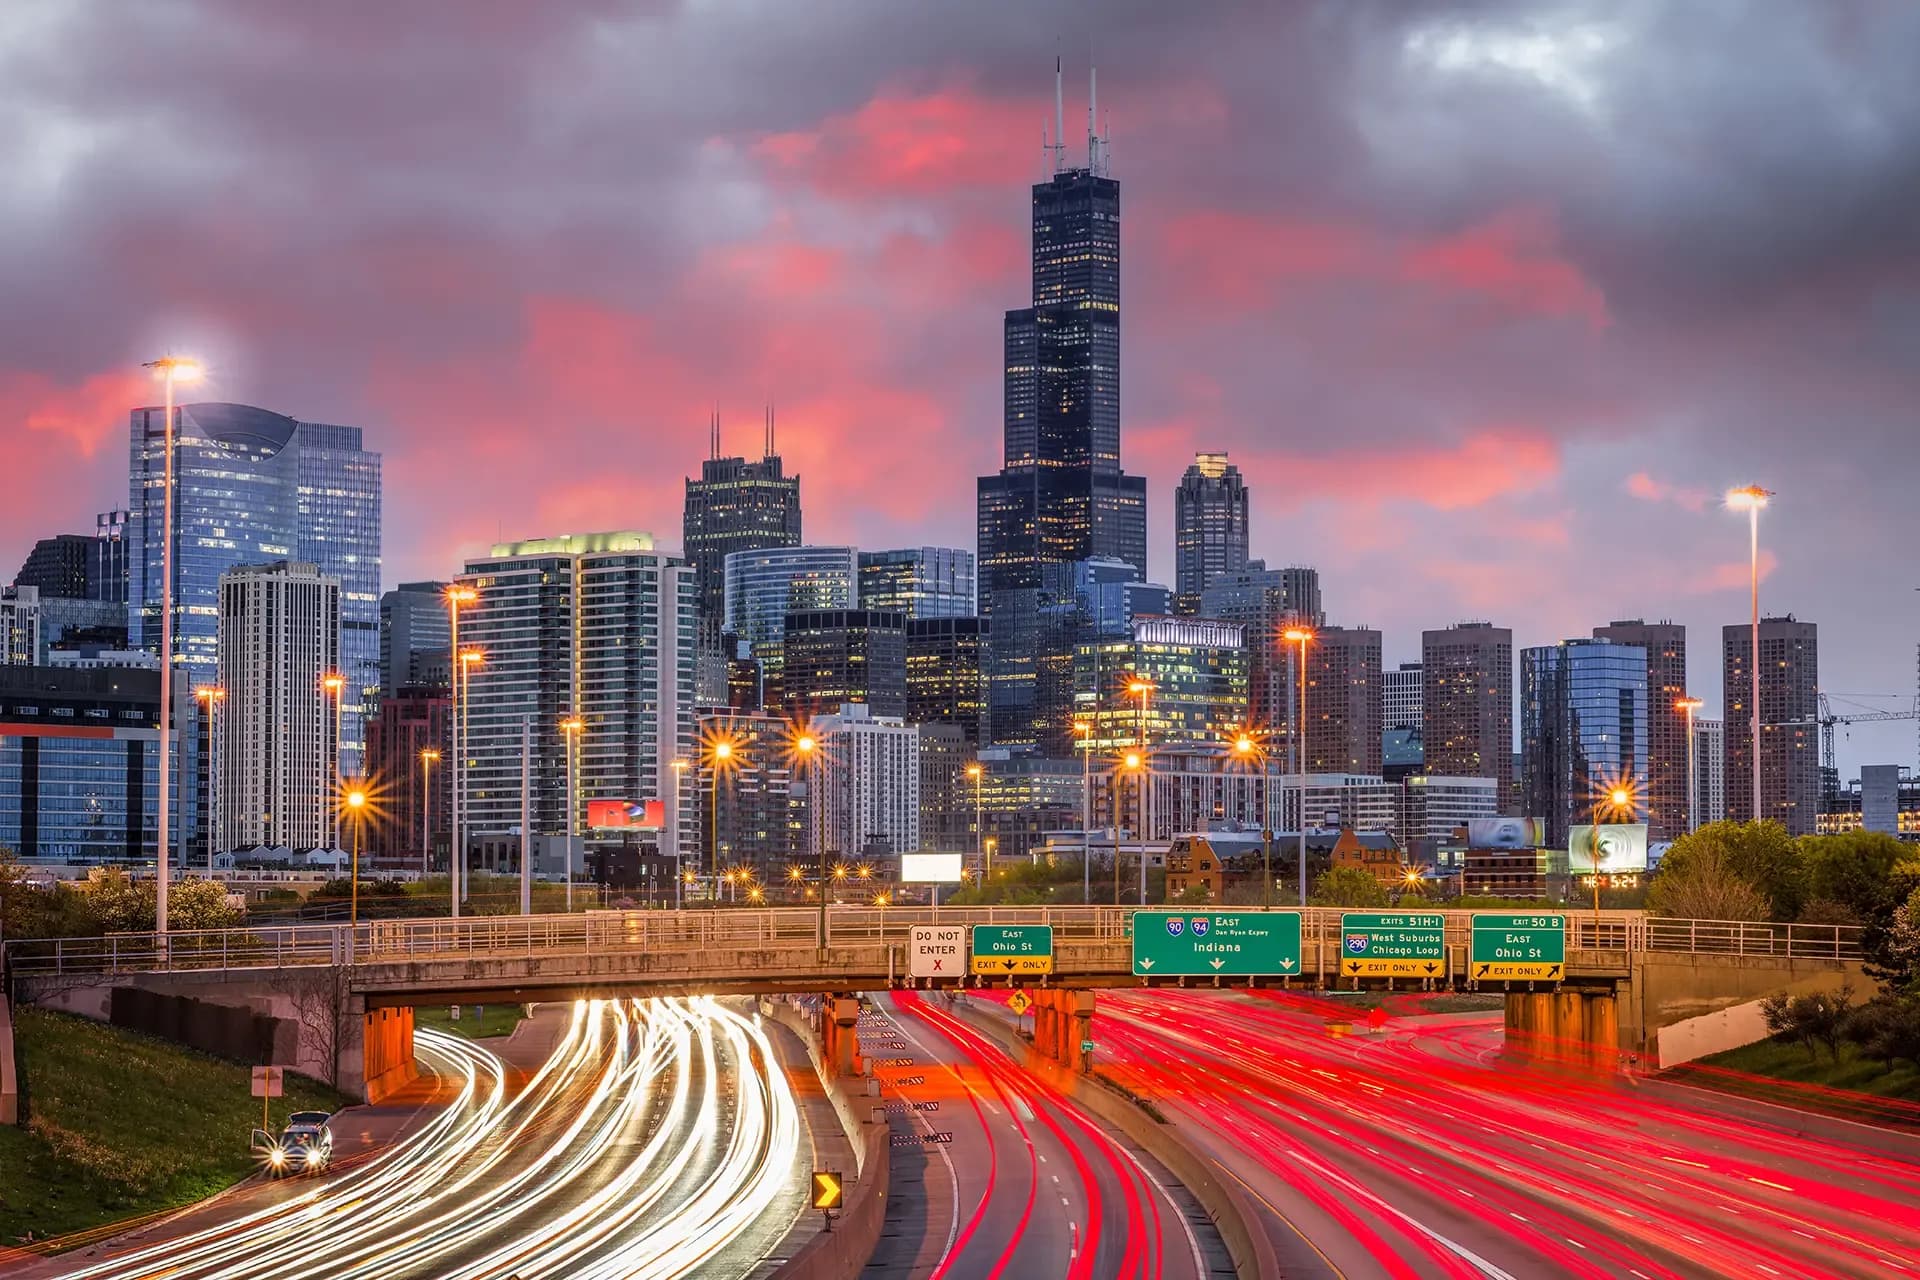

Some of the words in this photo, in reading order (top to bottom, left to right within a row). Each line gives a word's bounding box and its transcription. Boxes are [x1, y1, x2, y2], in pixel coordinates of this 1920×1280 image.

[1215, 917, 1240, 926] EAST
[1531, 917, 1546, 927] 50
[1551, 918, 1559, 927] B
[1168, 923, 1181, 932] 90
[1193, 923, 1207, 932] 94
[916, 931, 931, 941] DO
[938, 931, 960, 941] NOT
[1002, 930, 1023, 938] EAST
[1372, 933, 1394, 942] West
[1400, 933, 1441, 942] Suburbs
[1506, 934, 1531, 943] EAST
[992, 942, 1016, 951] Ohio
[1021, 942, 1033, 951] St
[1194, 943, 1241, 952] Indiana
[1349, 940, 1366, 949] 290
[920, 945, 956, 955] ENTER
[1372, 945, 1412, 956] Chicago
[1416, 946, 1440, 956] Loop
[1495, 948, 1522, 958] Ohio
[1529, 948, 1542, 958] St
[977, 961, 997, 969] EXIT
[1022, 961, 1047, 969] ONLY
[1368, 964, 1388, 972] EXIT
[1392, 964, 1417, 972] ONLY
[1494, 967, 1513, 975] EXIT
[1517, 967, 1542, 975] ONLY
